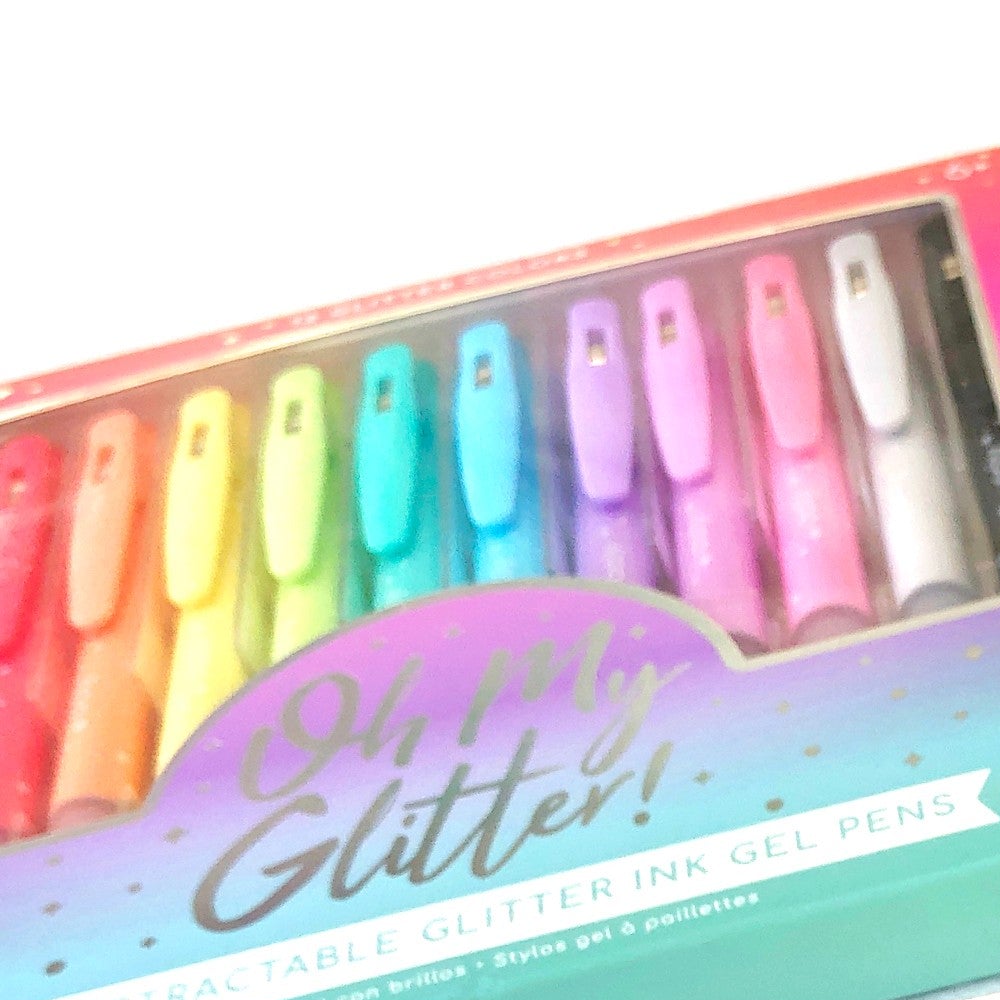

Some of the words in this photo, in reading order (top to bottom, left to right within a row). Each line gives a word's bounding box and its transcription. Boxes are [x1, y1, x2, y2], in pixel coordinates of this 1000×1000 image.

[239, 658, 429, 801] Oh
[458, 621, 693, 777] My
[192, 728, 675, 932] Glitter!
[421, 875, 614, 942] GLITTER
[634, 853, 708, 891] INK
[730, 829, 818, 866] GEL
[839, 793, 958, 840] PENS
[493, 940, 567, 968] Stylos
[576, 926, 613, 951] gel
[644, 892, 759, 935] paillettes
